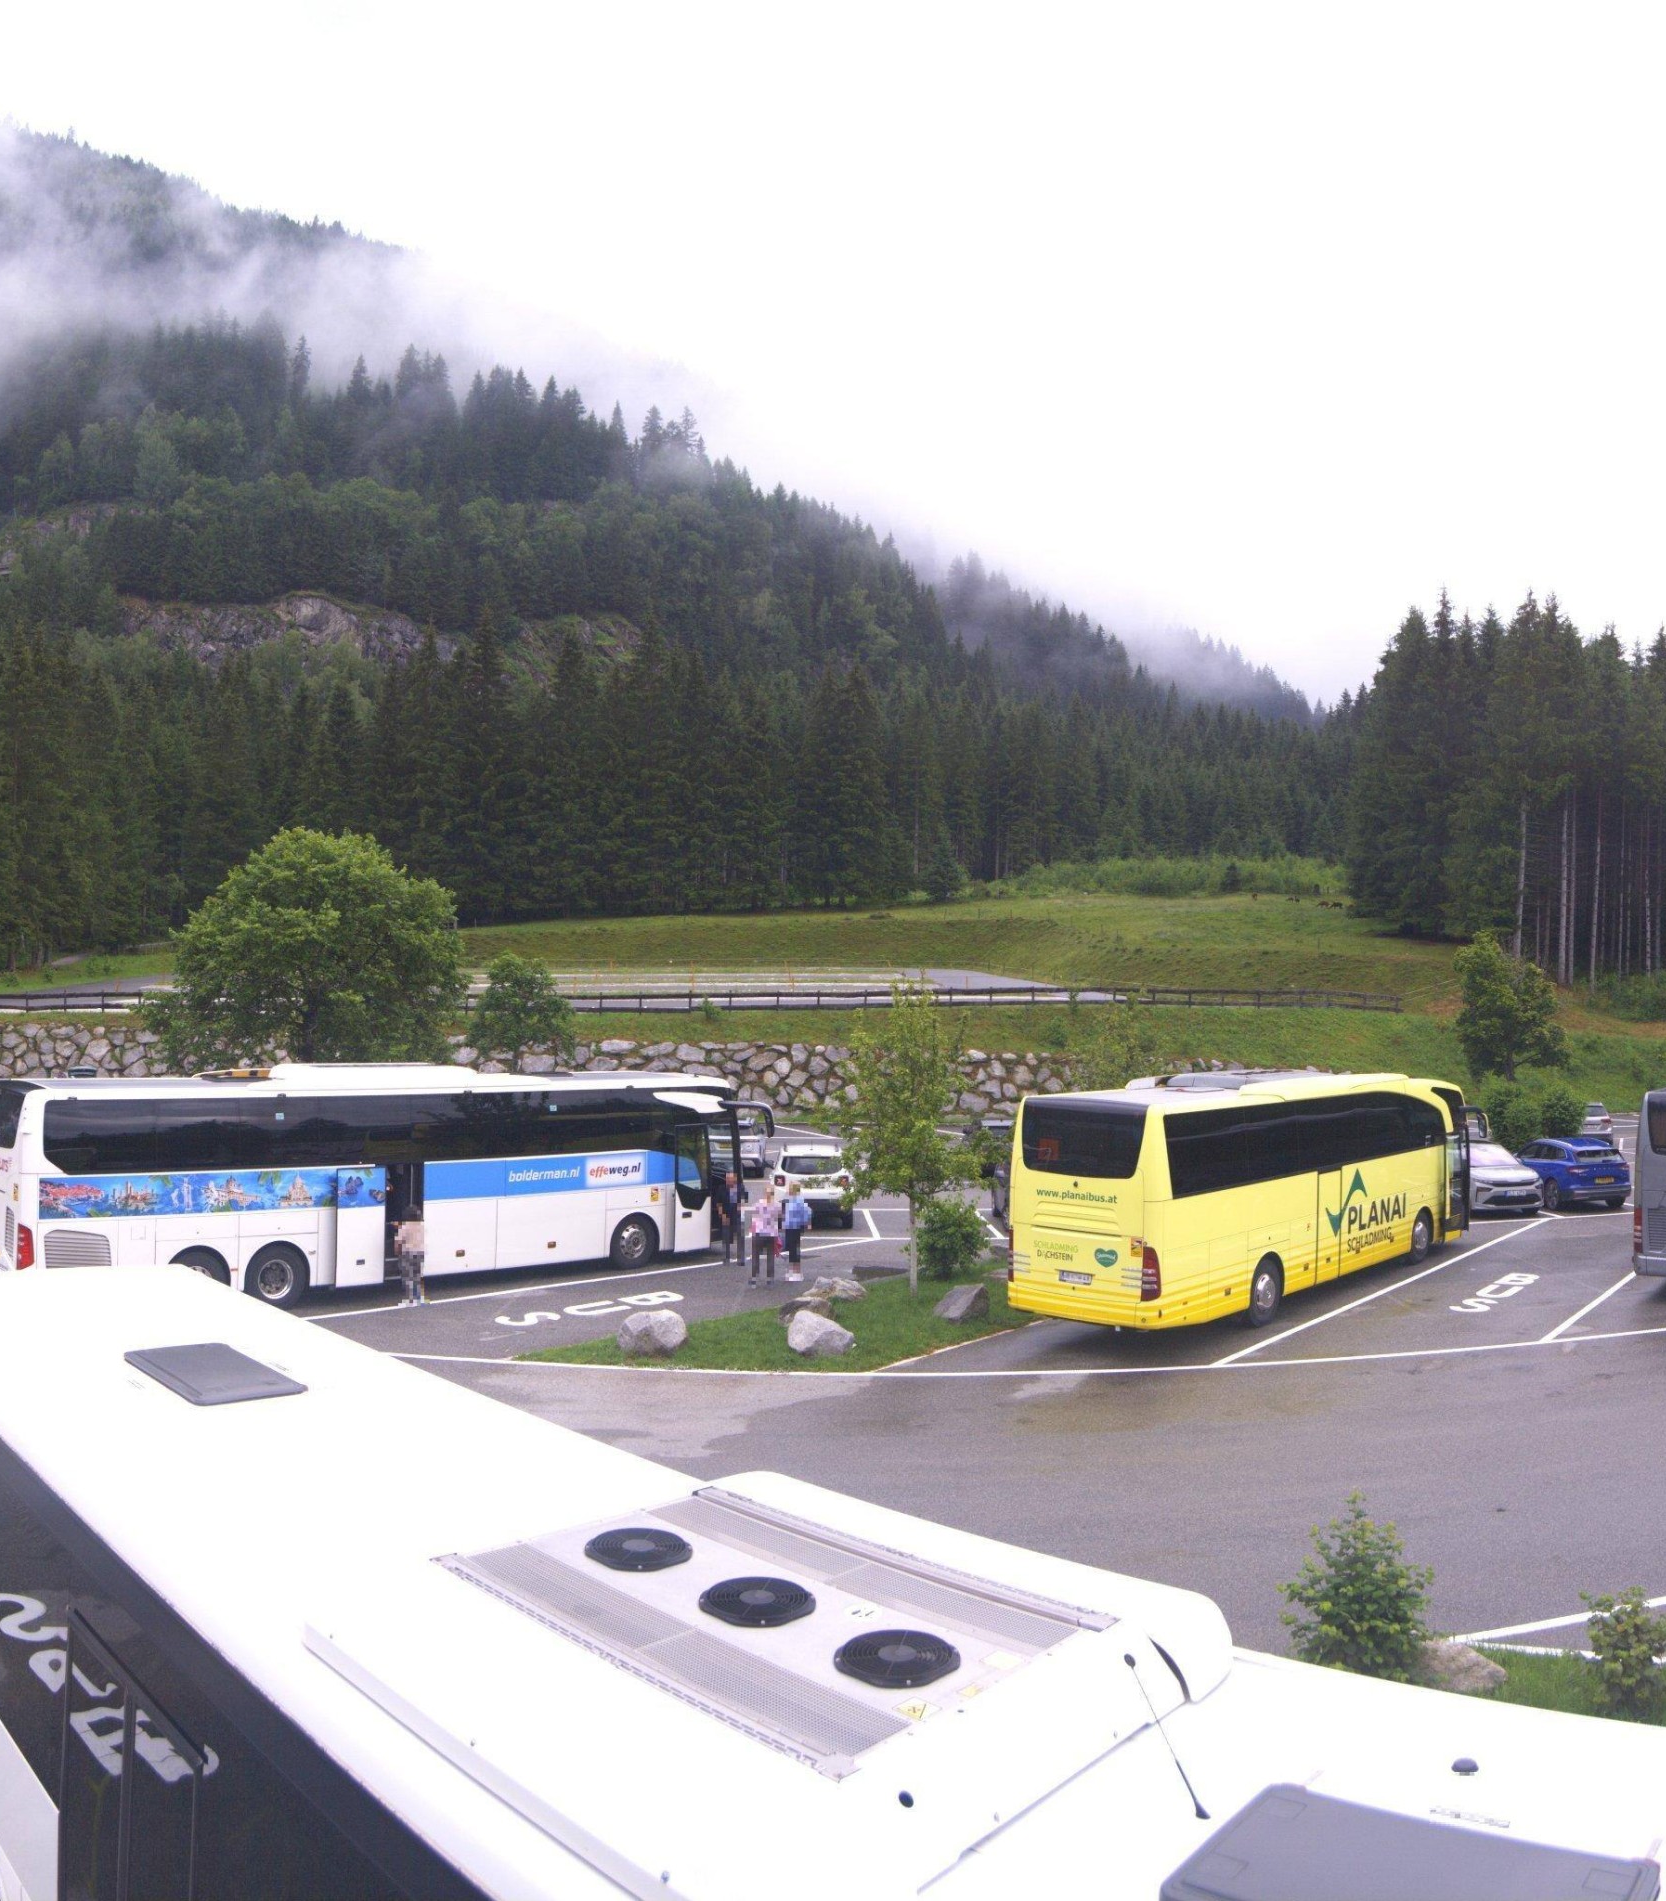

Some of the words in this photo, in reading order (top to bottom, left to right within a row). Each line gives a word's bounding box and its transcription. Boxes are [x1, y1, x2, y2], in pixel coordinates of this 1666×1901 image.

[508, 1166, 580, 1182] bolderman.nl
[589, 1162, 642, 1178] effeweg.nl
[1036, 1188, 1118, 1204] www.planaibus.at
[1347, 1193, 1407, 1235] PLANAI
[1033, 1240, 1079, 1254] SCHLADMING
[1346, 1226, 1392, 1253] SCHLADMING
[1448, 1272, 1540, 1312] BUS
[494, 1290, 685, 1326] BUS
